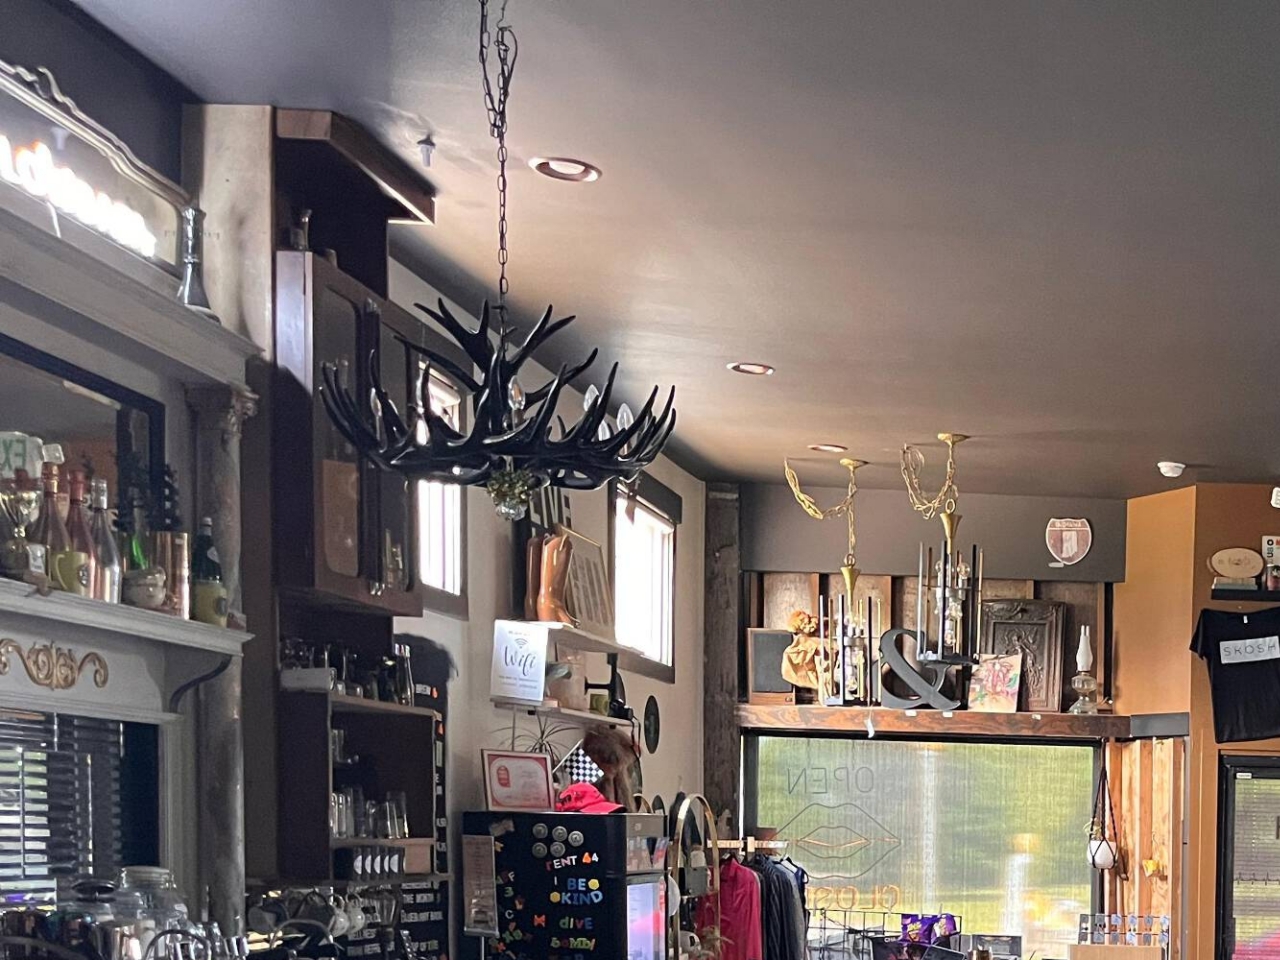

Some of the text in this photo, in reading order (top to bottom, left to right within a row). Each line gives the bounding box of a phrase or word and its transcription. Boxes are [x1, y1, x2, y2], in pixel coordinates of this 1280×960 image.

[1223, 643, 1277, 657] SKOSH
[504, 645, 536, 677] Wifi
[567, 878, 586, 891] BE
[561, 890, 603, 905] KIND
